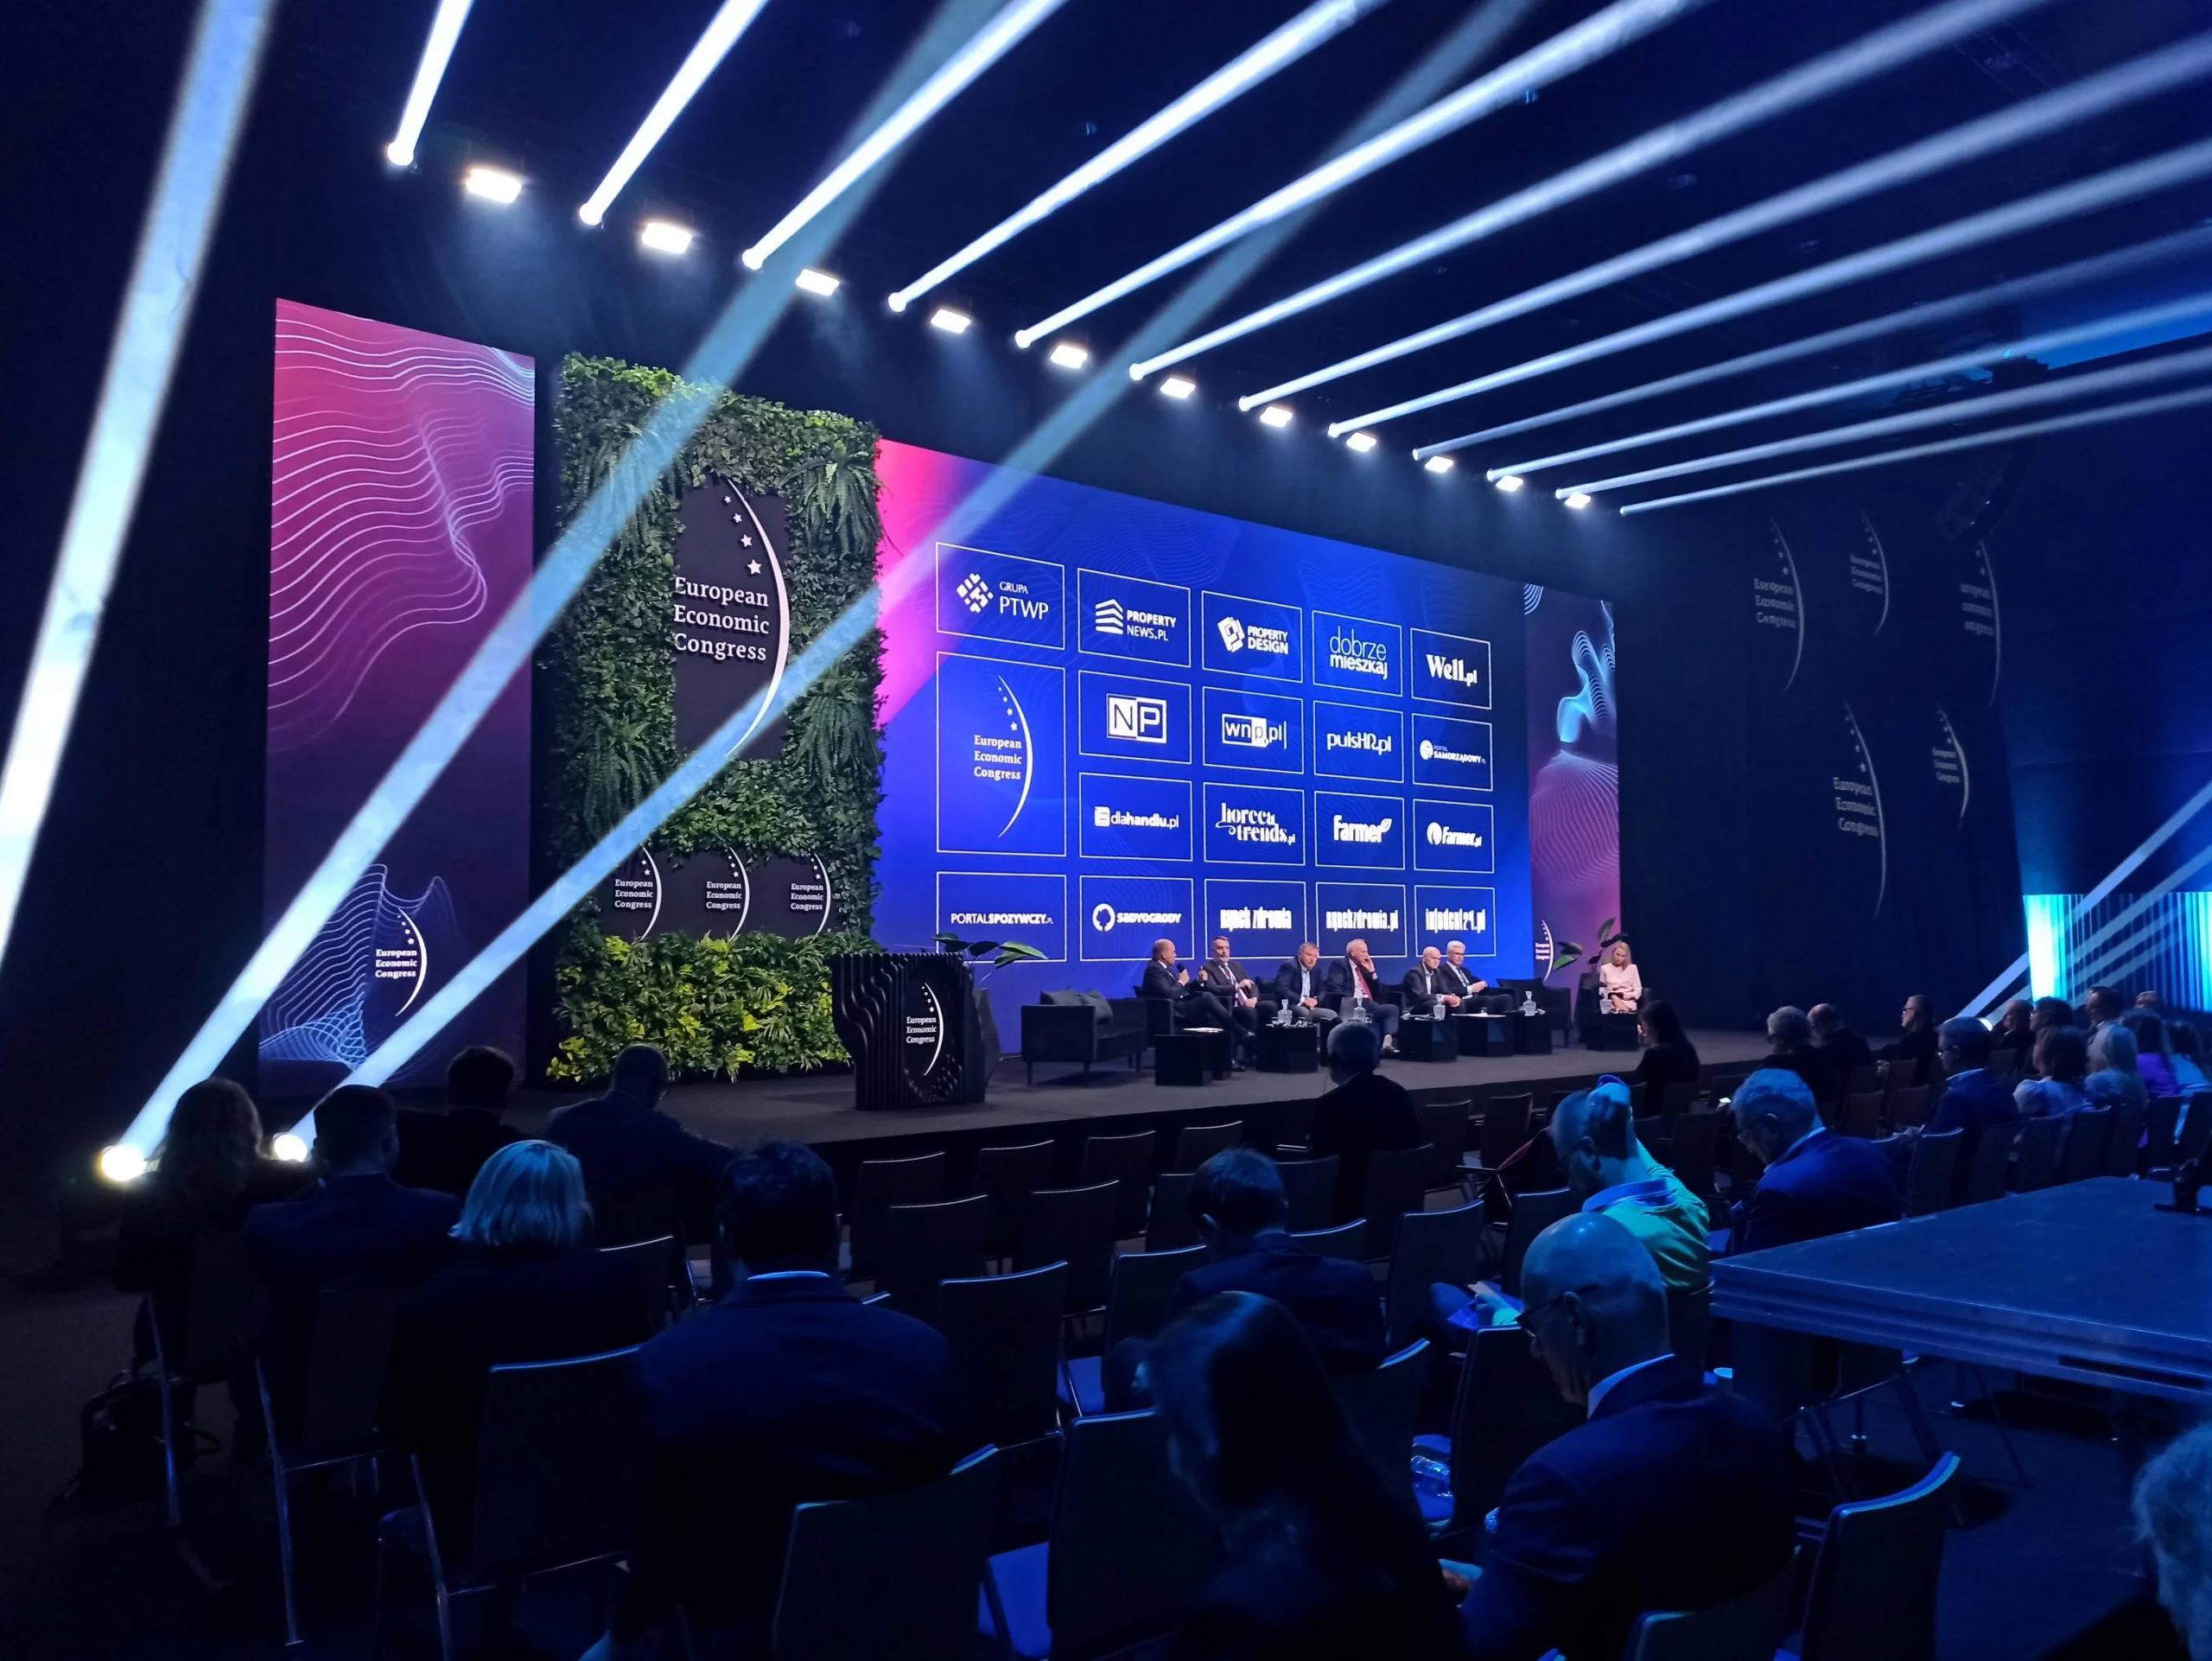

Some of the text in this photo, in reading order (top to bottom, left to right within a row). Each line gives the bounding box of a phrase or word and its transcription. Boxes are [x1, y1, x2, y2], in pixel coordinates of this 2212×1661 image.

[674, 576, 769, 607] European
[999, 581, 1028, 595] GRUPA
[999, 595, 1049, 620] PTWP
[673, 605, 770, 634] Economic
[1126, 608, 1177, 628] PROPERTY
[1126, 626, 1168, 641] NEWS.PL
[1247, 626, 1287, 641] PROPERTY
[675, 633, 767, 661] Congress
[1247, 639, 1289, 655] DESIGN
[1329, 625, 1387, 661] dobrze
[1330, 652, 1388, 680] mieszkaj
[1426, 653, 1478, 687] Well.pl
[974, 735, 1022, 749] European
[1327, 731, 1392, 755] pulsHR.pl
[974, 750, 1022, 765] Economic
[974, 767, 1021, 780] Congress
[1110, 811, 1179, 830] dlahandlu.pl
[614, 879, 653, 889] European
[706, 881, 742, 891] European
[791, 882, 823, 892] European
[614, 889, 653, 899] Economic
[706, 891, 742, 901] Economic
[791, 892, 823, 901] Economic
[614, 900, 652, 910] Congress
[706, 901, 741, 911] Congress
[791, 902, 823, 912] Congress
[376, 949, 417, 958] European
[375, 959, 417, 968] Economic
[375, 970, 416, 979] Congress
[906, 1016, 937, 1025] European
[906, 1035, 935, 1045] Congress
